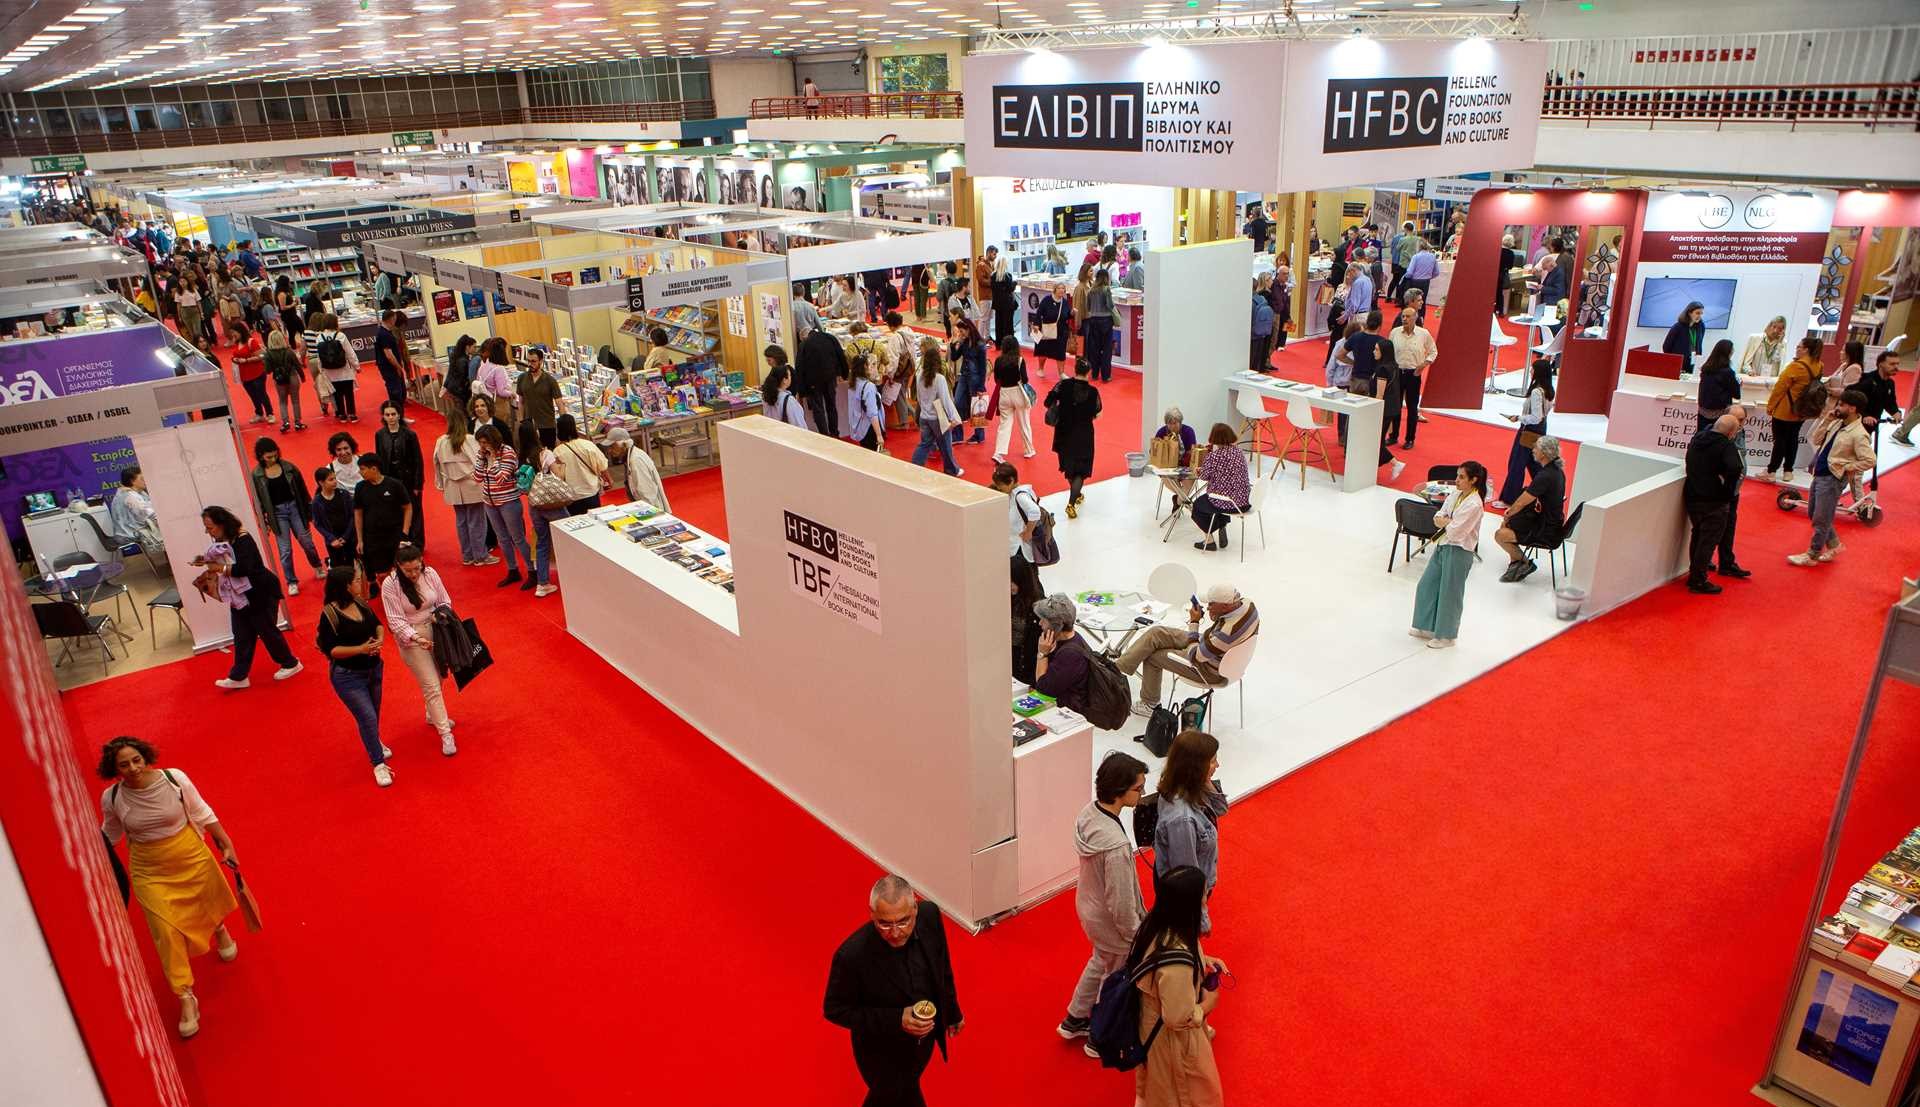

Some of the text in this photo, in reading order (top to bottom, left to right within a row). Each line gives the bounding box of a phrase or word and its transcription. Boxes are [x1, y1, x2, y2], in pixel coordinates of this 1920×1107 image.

[1146, 80, 1221, 97] ΕΛΛΗΝΙΚΟ
[1451, 75, 1497, 91] HELLENIC
[1145, 100, 1200, 116] ΙΔΡΥΜΑ
[1449, 92, 1512, 109] FOUNDATION
[1000, 92, 1137, 139] ΕΛΙΒΙΠ
[1331, 89, 1440, 141] HFBC
[1447, 110, 1503, 127] FOR BOOKS
[1146, 119, 1232, 135] ΒΙΒΛΙΟΥ ΚΑΙ
[1445, 127, 1510, 145] AND CULTURE
[1145, 137, 1234, 156] ΠΟΛΙΤΙΣΜΟΥ
[350, 221, 454, 242] UNIVERSITY STUDIO PRESS
[1669, 235, 1704, 243] Αποκτήστε
[1705, 235, 1739, 244] πρόσβαση
[1757, 234, 1798, 244] πληροφορία
[1672, 252, 1788, 262] στην Εθνική Βιβλιοθήκη της Ελλάδος
[1699, 244, 1720, 253] γνώση
[1720, 245, 1730, 253] με
[1730, 245, 1742, 253] την
[1743, 244, 1771, 254] εγγραφή
[1772, 245, 1785, 253] σας
[63, 360, 114, 374] ΟΡΓΑΝΙΣΜΟΣ
[65, 369, 114, 383] ΣΥΛΛΟΓΙΚΗΣ
[68, 377, 114, 391] ΔΙΑΧΕΙΡΙΣΗΣ
[104, 406, 131, 418] OSDEL
[1660, 423, 1679, 436] της
[786, 515, 836, 556] HFBC
[838, 532, 865, 549] HELLENIC
[838, 540, 875, 561] FOUNDATION
[839, 549, 871, 568] FOR BOOKS
[787, 551, 831, 598] TBF
[840, 558, 878, 580] AND CULTURE
[838, 582, 880, 607] THESSALONIKI
[827, 600, 858, 622] BOOK FAIR
[833, 592, 879, 620] INTERNATIONAL
